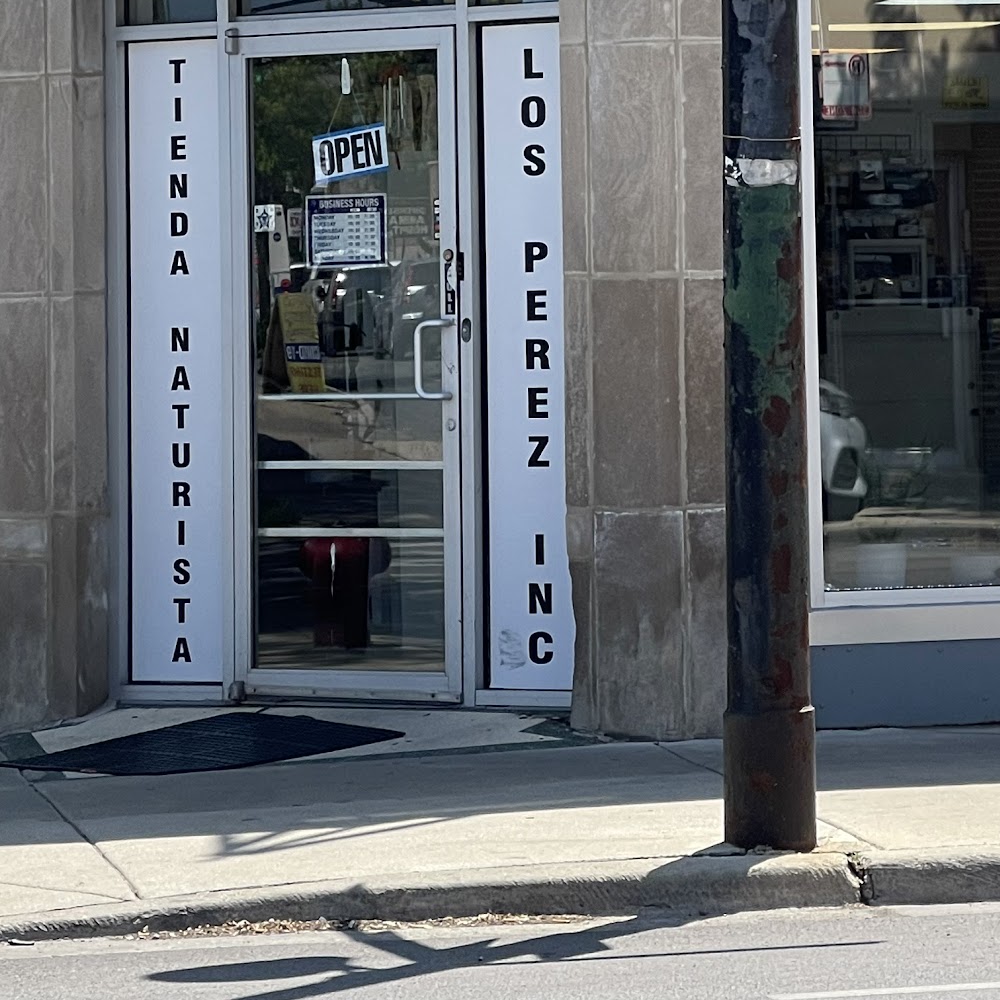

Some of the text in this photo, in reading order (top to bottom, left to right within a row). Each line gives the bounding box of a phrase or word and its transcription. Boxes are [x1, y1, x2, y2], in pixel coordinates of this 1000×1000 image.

[319, 129, 384, 176] OPEN
[319, 197, 379, 210] BUSINESS HOURS
[167, 57, 193, 664] TIENDA NATURISTA
[521, 48, 554, 667] LOS PEREZ INC
